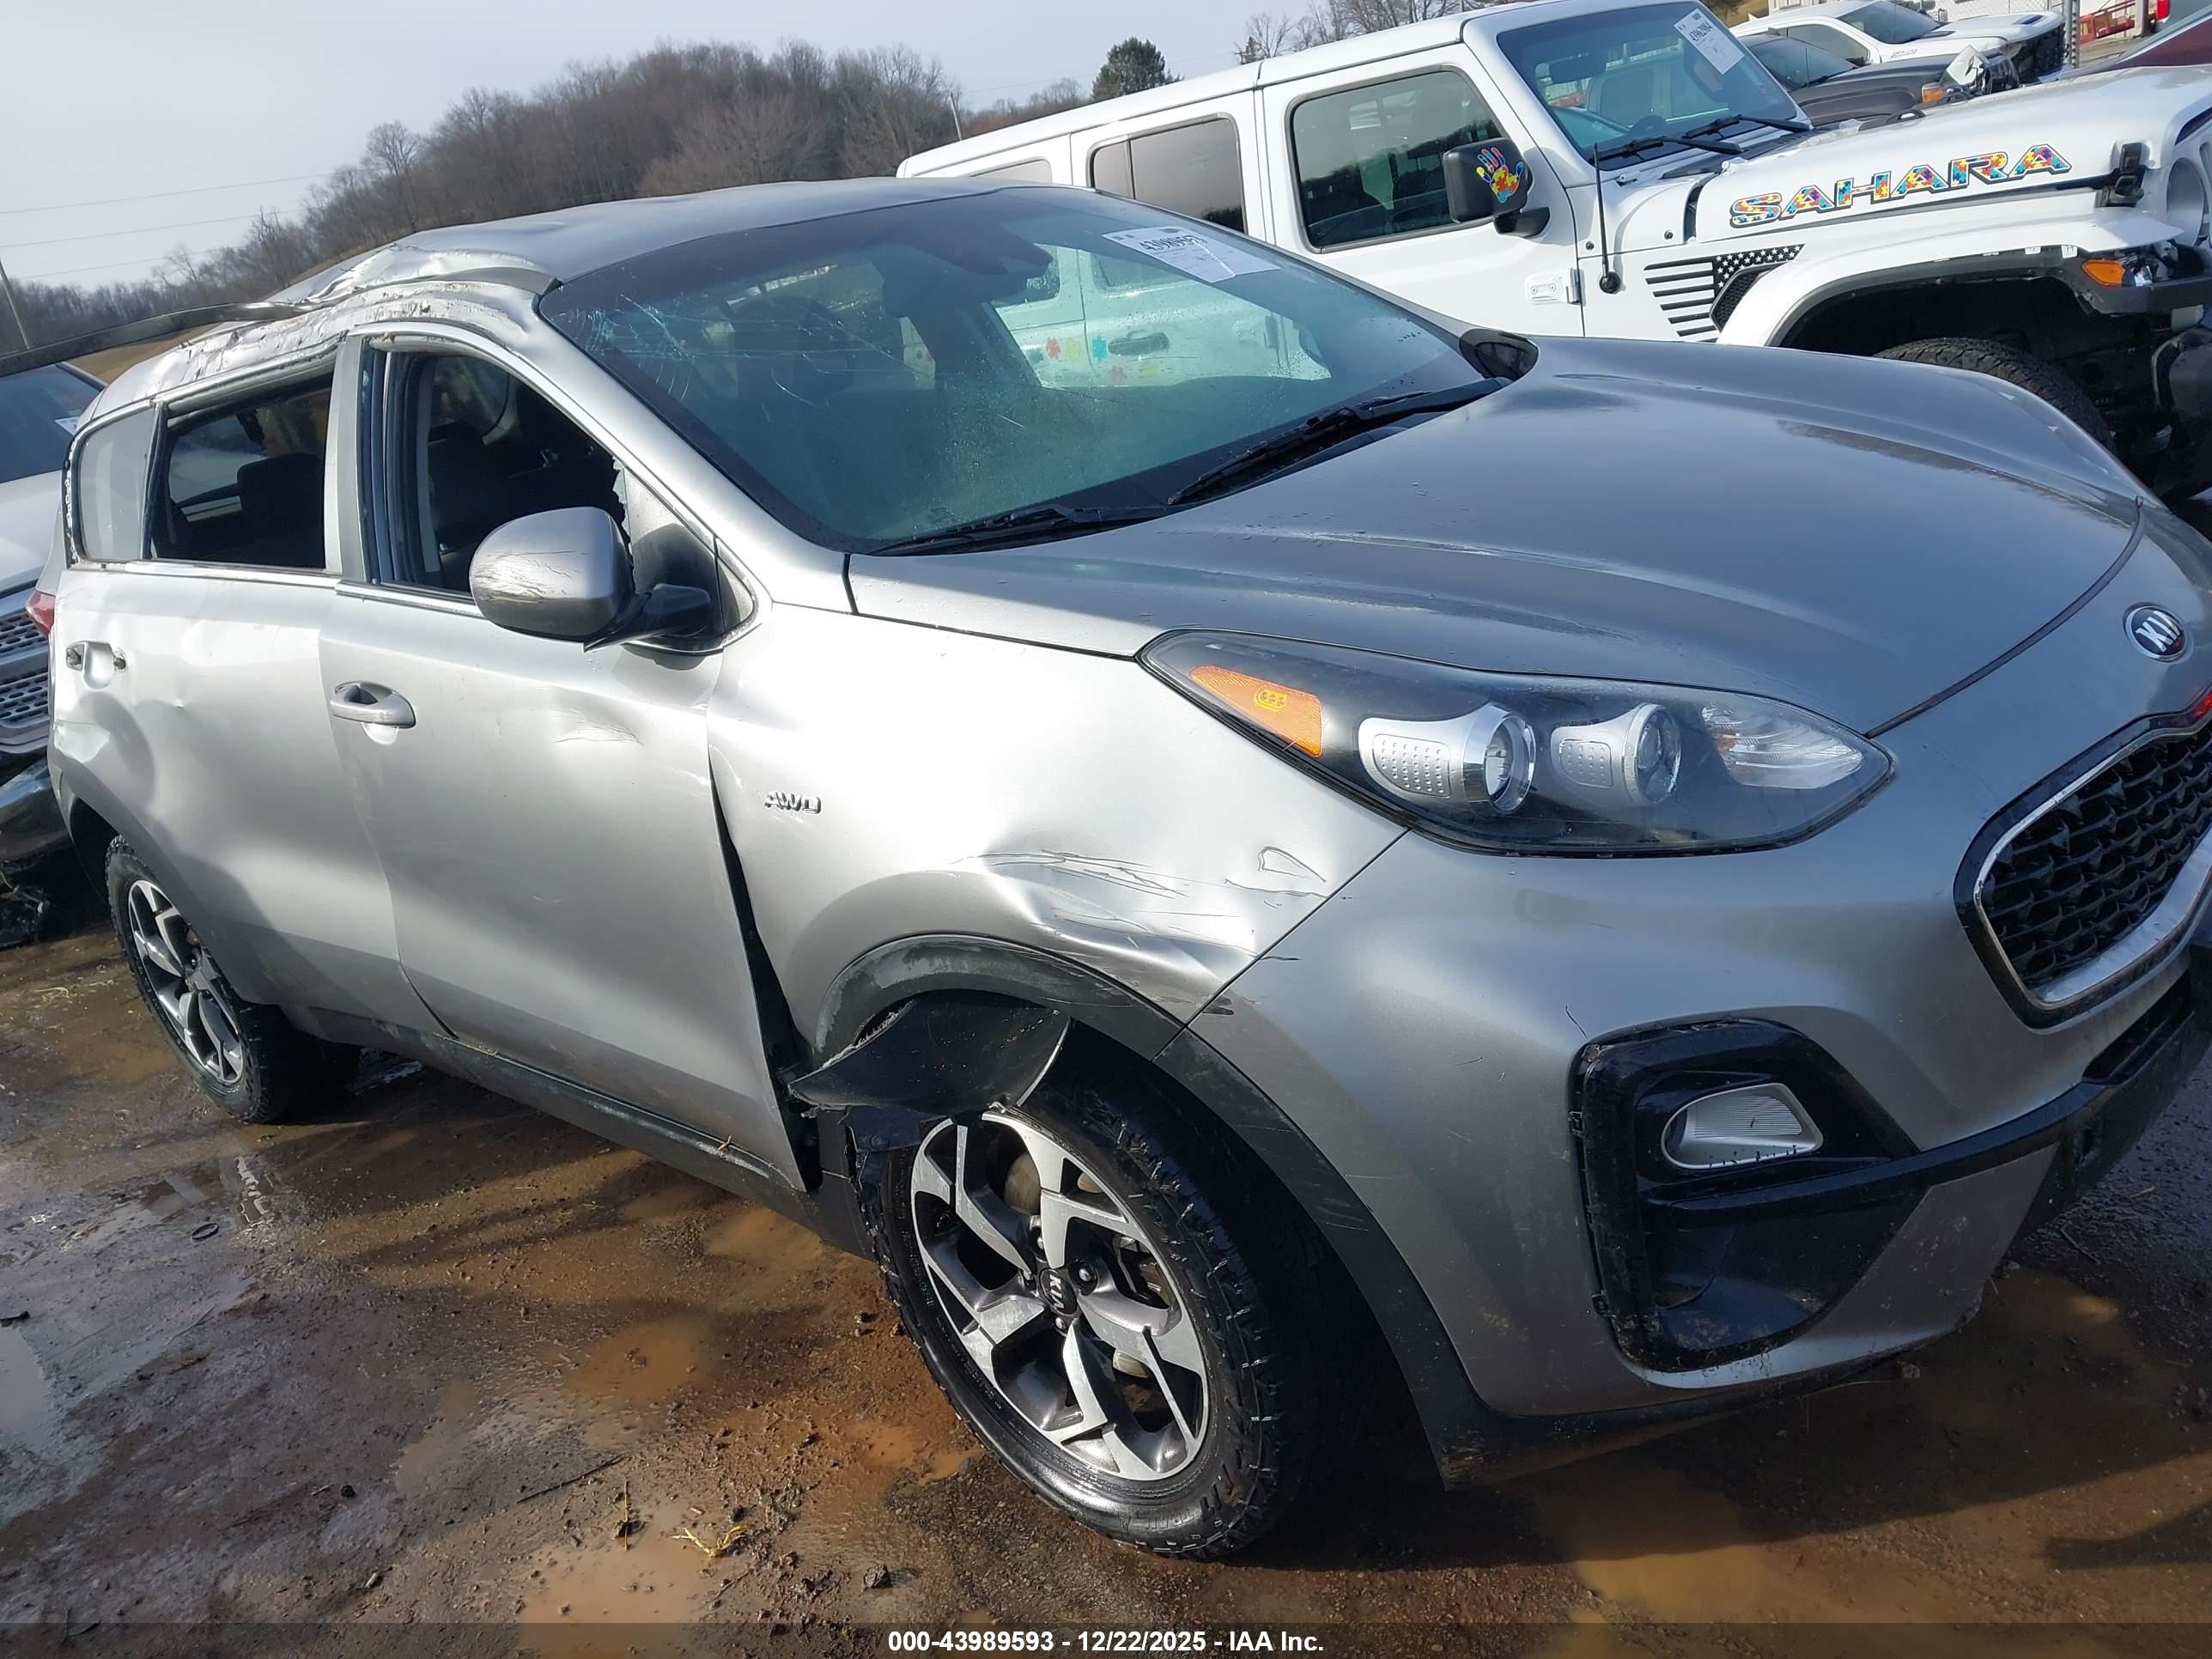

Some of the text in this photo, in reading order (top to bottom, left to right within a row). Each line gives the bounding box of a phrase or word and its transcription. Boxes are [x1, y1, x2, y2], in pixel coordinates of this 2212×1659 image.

[1730, 144, 2073, 228] SAHARA
[2136, 611, 2180, 652] KIA
[763, 791, 822, 814] AWD
[1049, 1273, 1065, 1309] KIA
